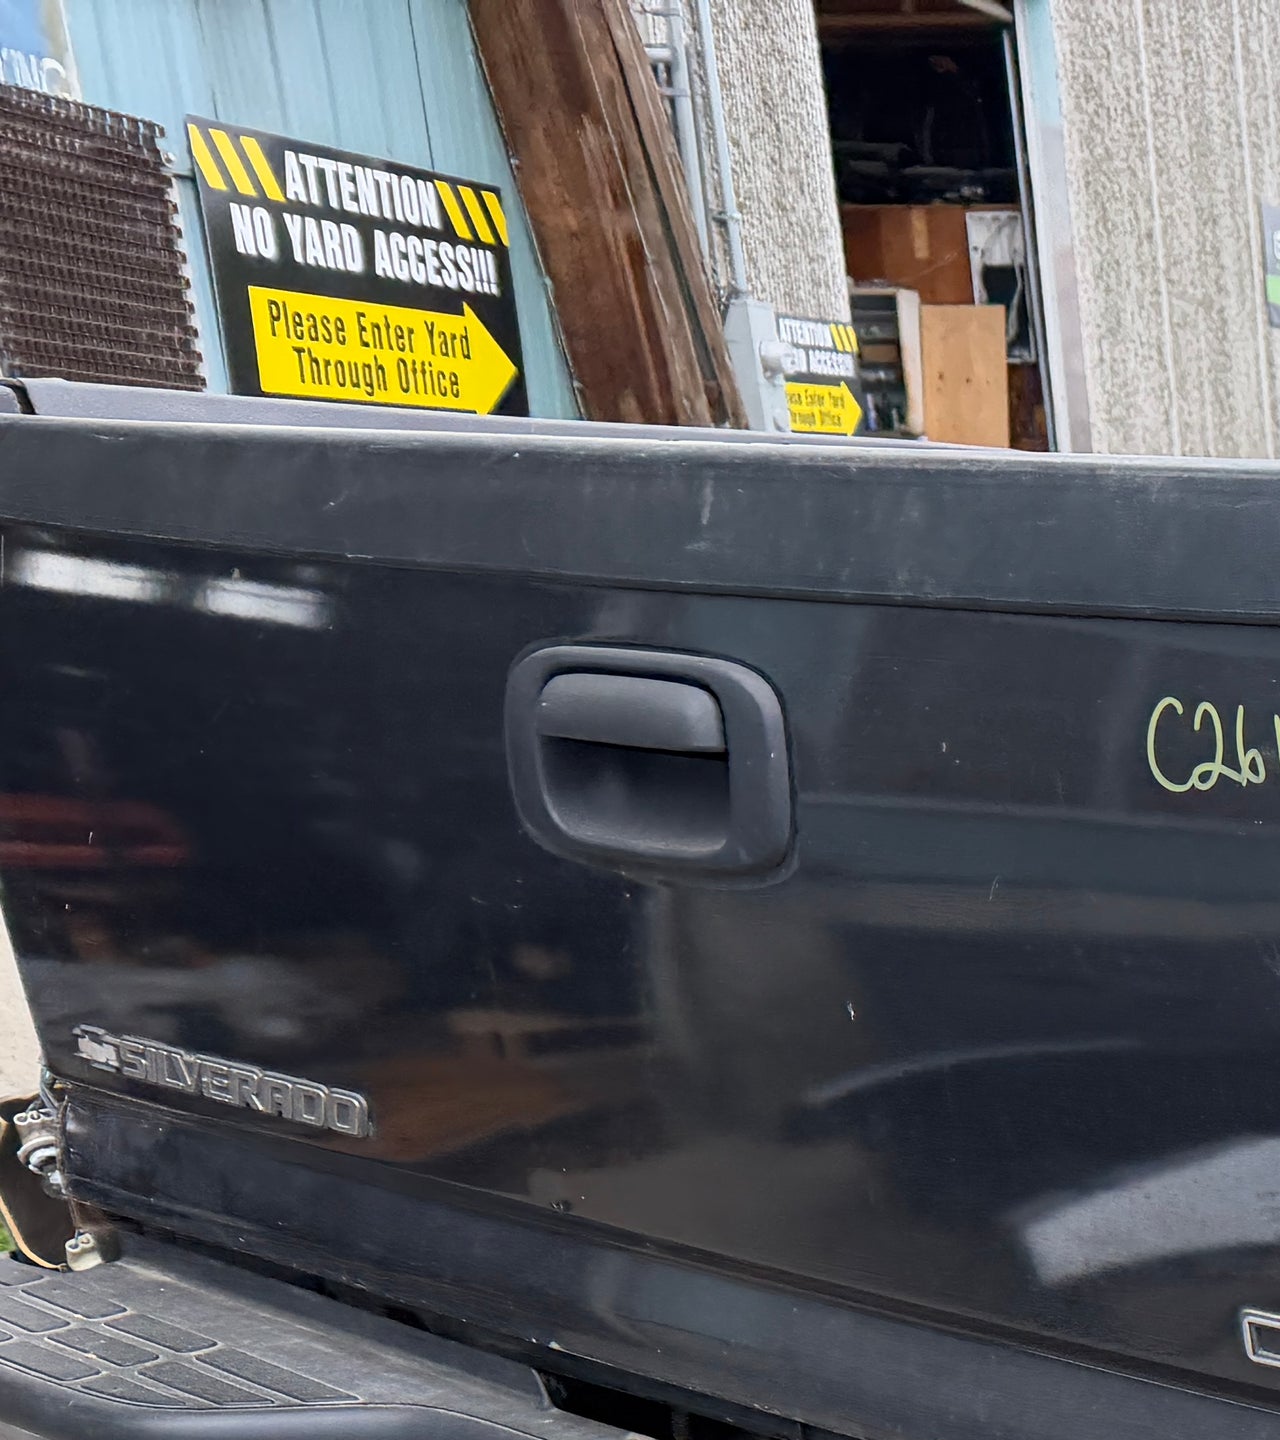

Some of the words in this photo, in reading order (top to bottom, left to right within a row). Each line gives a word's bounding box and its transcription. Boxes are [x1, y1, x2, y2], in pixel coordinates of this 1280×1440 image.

[284, 150, 442, 229] ATTENTION
[229, 202, 279, 260] NO
[282, 213, 364, 273] YARD
[374, 229, 501, 297] ACCESS!!!
[267, 299, 346, 346] Please
[356, 311, 414, 354] Enter
[424, 320, 472, 360] Yard
[292, 346, 388, 397] Through
[396, 357, 460, 399] Office
[118, 1033, 373, 1139] SILVERADO
